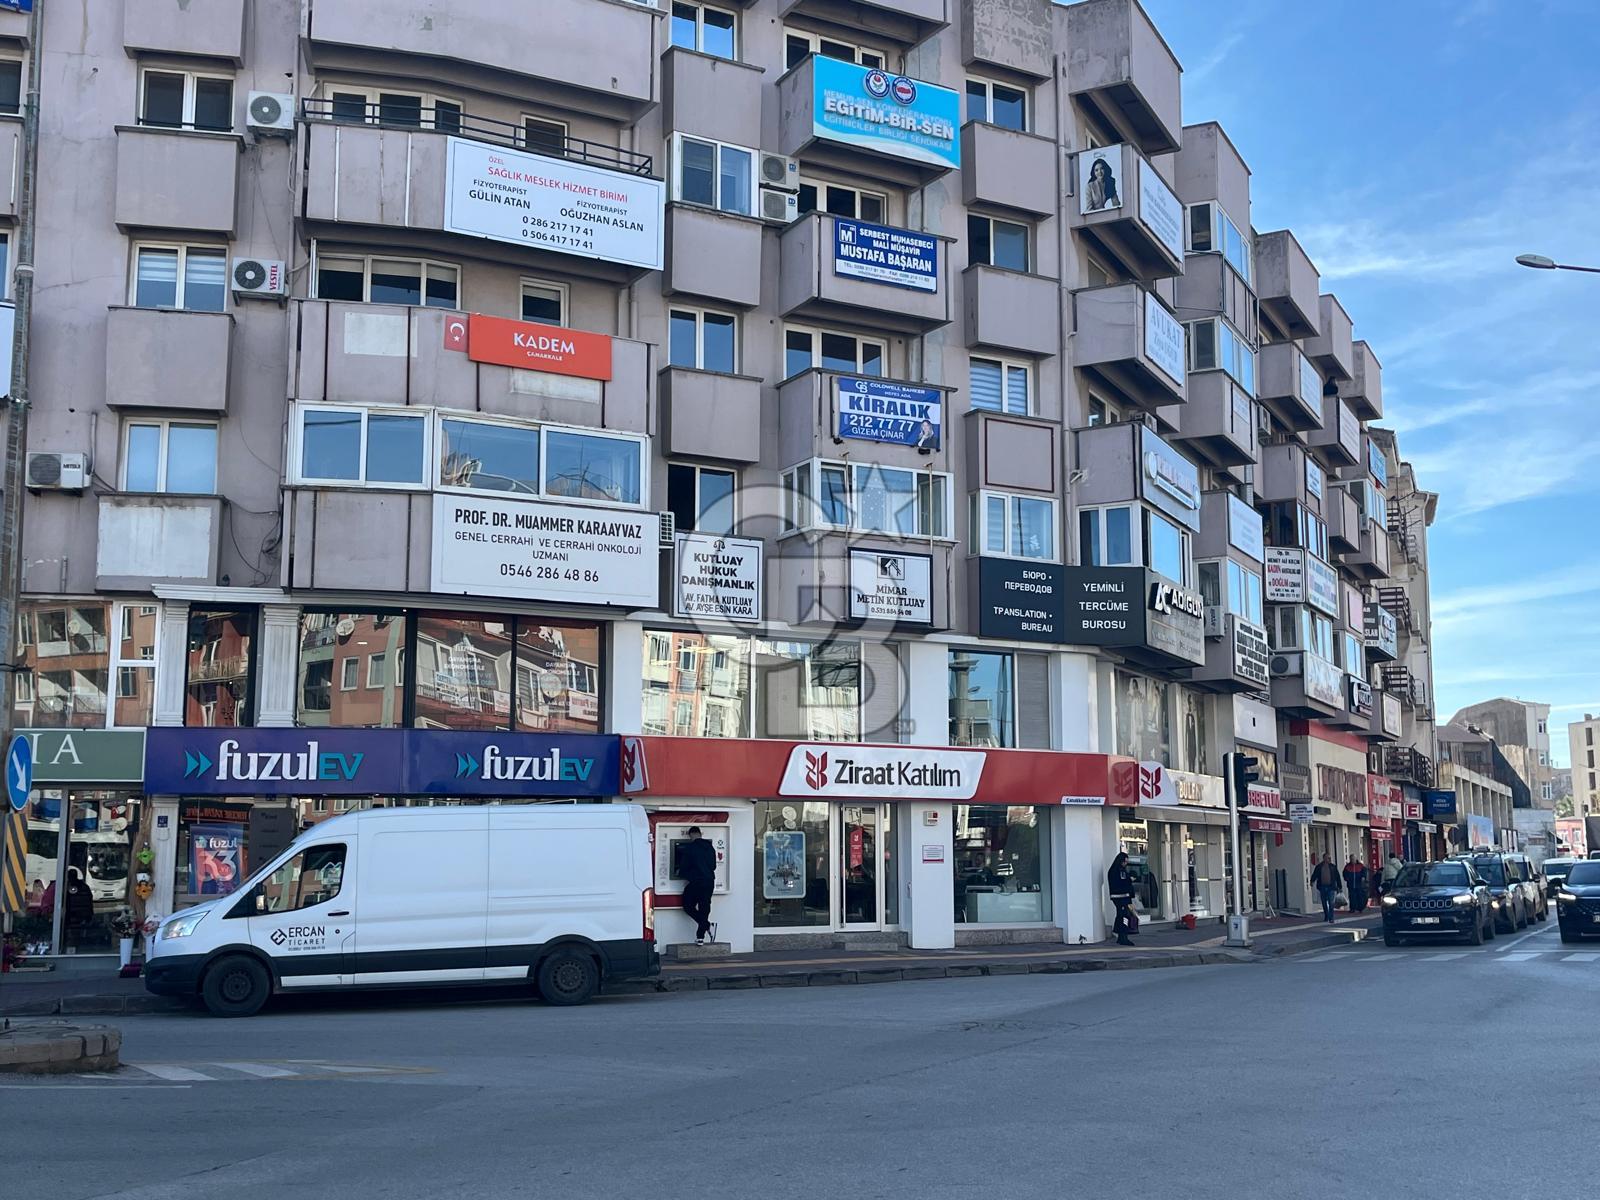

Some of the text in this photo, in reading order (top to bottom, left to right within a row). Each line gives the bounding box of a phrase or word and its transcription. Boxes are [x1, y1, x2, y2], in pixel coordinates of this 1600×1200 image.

[473, 179, 527, 195] FİZYOTERAPİST
[488, 166, 628, 203] SAĞLIK MESLEK HİZMET BİRİMİ
[469, 188, 531, 209] GÜLİN ATAN
[577, 200, 628, 216] FİZYOTERAPİST
[522, 216, 593, 237] 0 286 217 17 41
[560, 207, 644, 232] OĞUZHAN ASLAN
[522, 229, 593, 250] 0 506 417 17 41
[860, 228, 934, 250] SERBEST MUHASEBECİ
[891, 242, 920, 256] MÜŞAVİR
[840, 244, 932, 270] MUSTAFA BAŞARAN
[1151, 306, 1181, 349] AVUKAT
[514, 332, 576, 354] KADEM
[870, 382, 900, 392] COLDWELL
[848, 395, 930, 420] KİRALIK
[850, 414, 914, 432] 212 77 77
[852, 426, 904, 440] GİZEM ÇINAR
[455, 508, 642, 539] PROF. DR. MUAMMER KARAAYVAZ
[455, 531, 642, 555] GENEL CERRAHİ VE CERRAHİ ONKOLOJİ
[532, 550, 568, 562] UZMANI
[694, 553, 744, 566] KUTLUAY
[500, 564, 599, 582] 0546 286 48 86
[700, 566, 738, 578] HUKUK
[1022, 570, 1046, 580] БЮРО
[682, 576, 754, 590] DANIŞMANLIK
[876, 584, 908, 596] MİMAR
[1004, 581, 1052, 594] ПЕРЕВОДОВ
[1083, 581, 1124, 592] YEMİNLİ
[696, 594, 719, 604] FATMA
[722, 596, 752, 606] KUTLUAY
[857, 594, 925, 608] METİN KUTLUAY
[1079, 600, 1128, 611] TERCÜME
[696, 604, 714, 614] AYŞE
[715, 604, 730, 614] ESİN
[732, 606, 752, 615] KARA
[1021, 622, 1052, 632] BUREAU
[834, 760, 960, 786] Ziraat Katılım
[210, 837, 238, 848] fuzul
[288, 926, 324, 938] ERCAN
